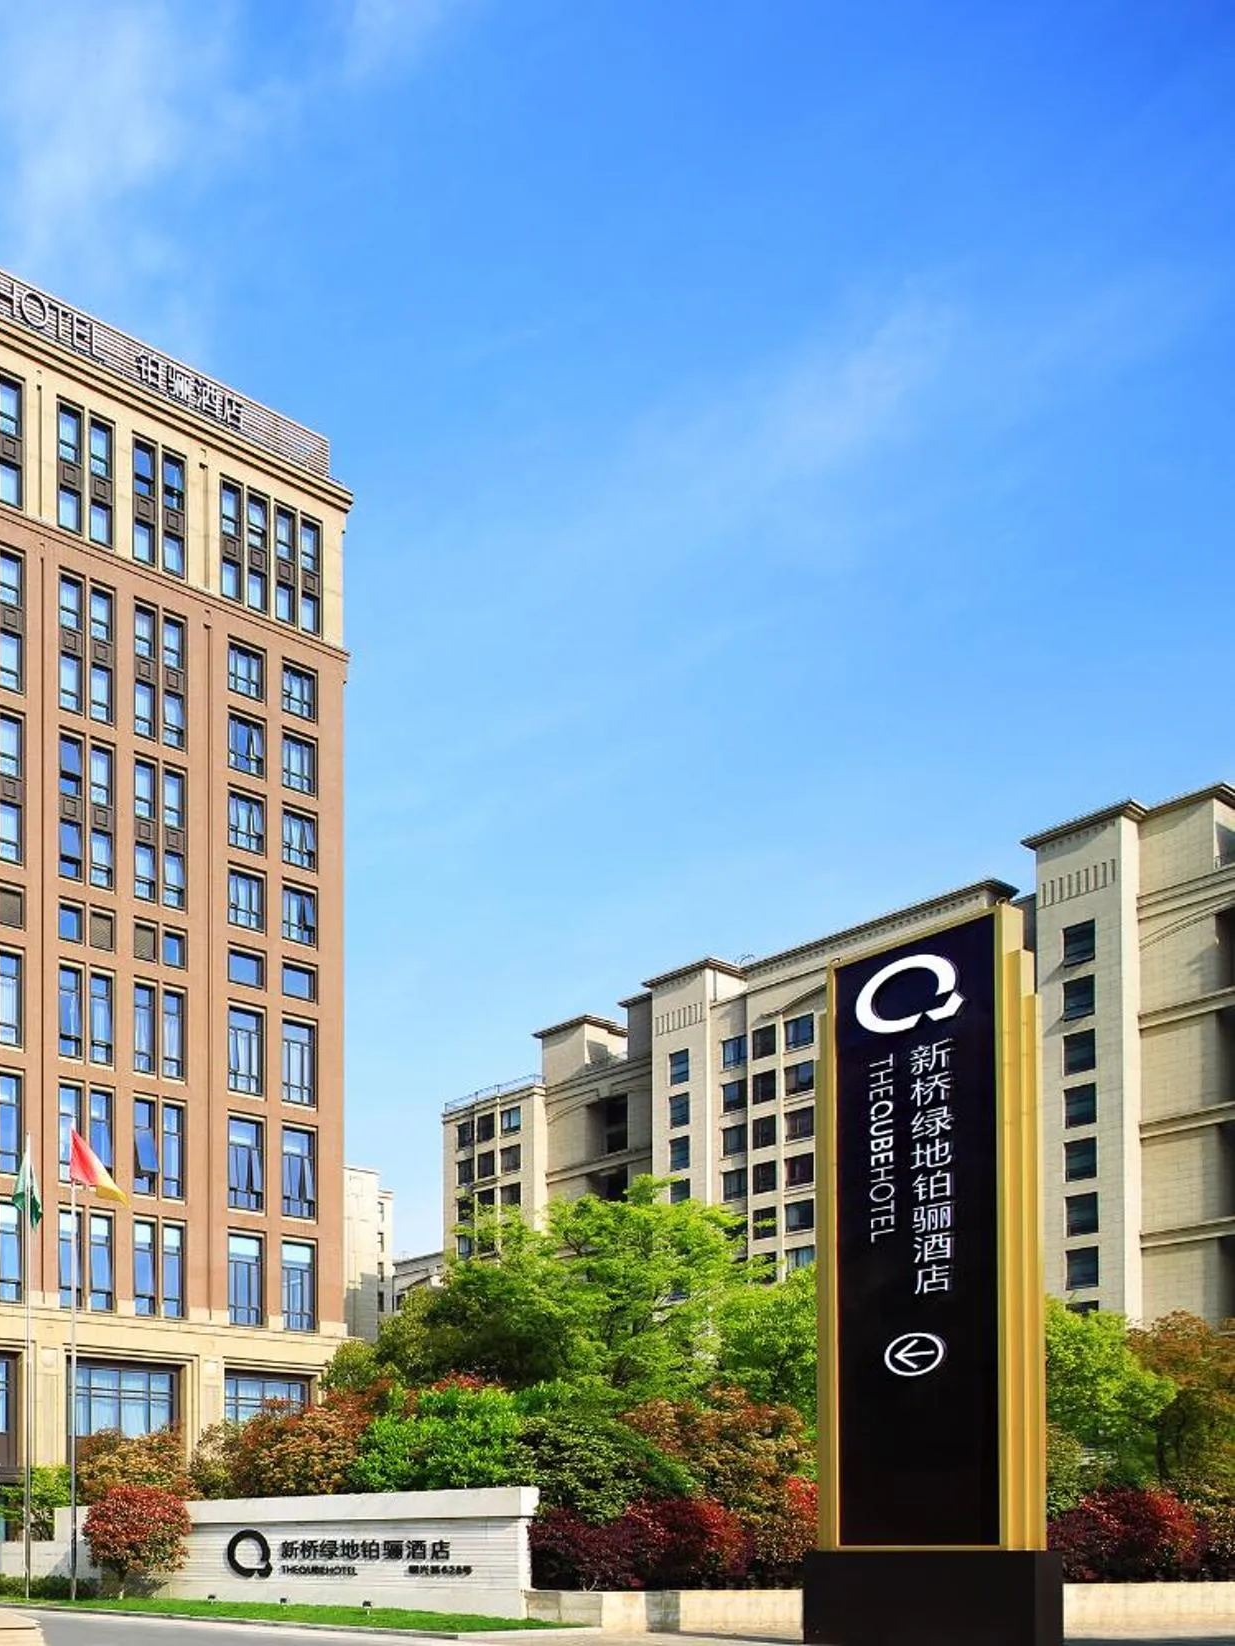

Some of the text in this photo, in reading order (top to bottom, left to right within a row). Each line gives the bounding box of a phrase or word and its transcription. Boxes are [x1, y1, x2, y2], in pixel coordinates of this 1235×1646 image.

[909, 1037, 955, 1295] 新桥绿地铂骊酒店
[281, 1540, 450, 1560] 新桥绿地铂骊酒店
